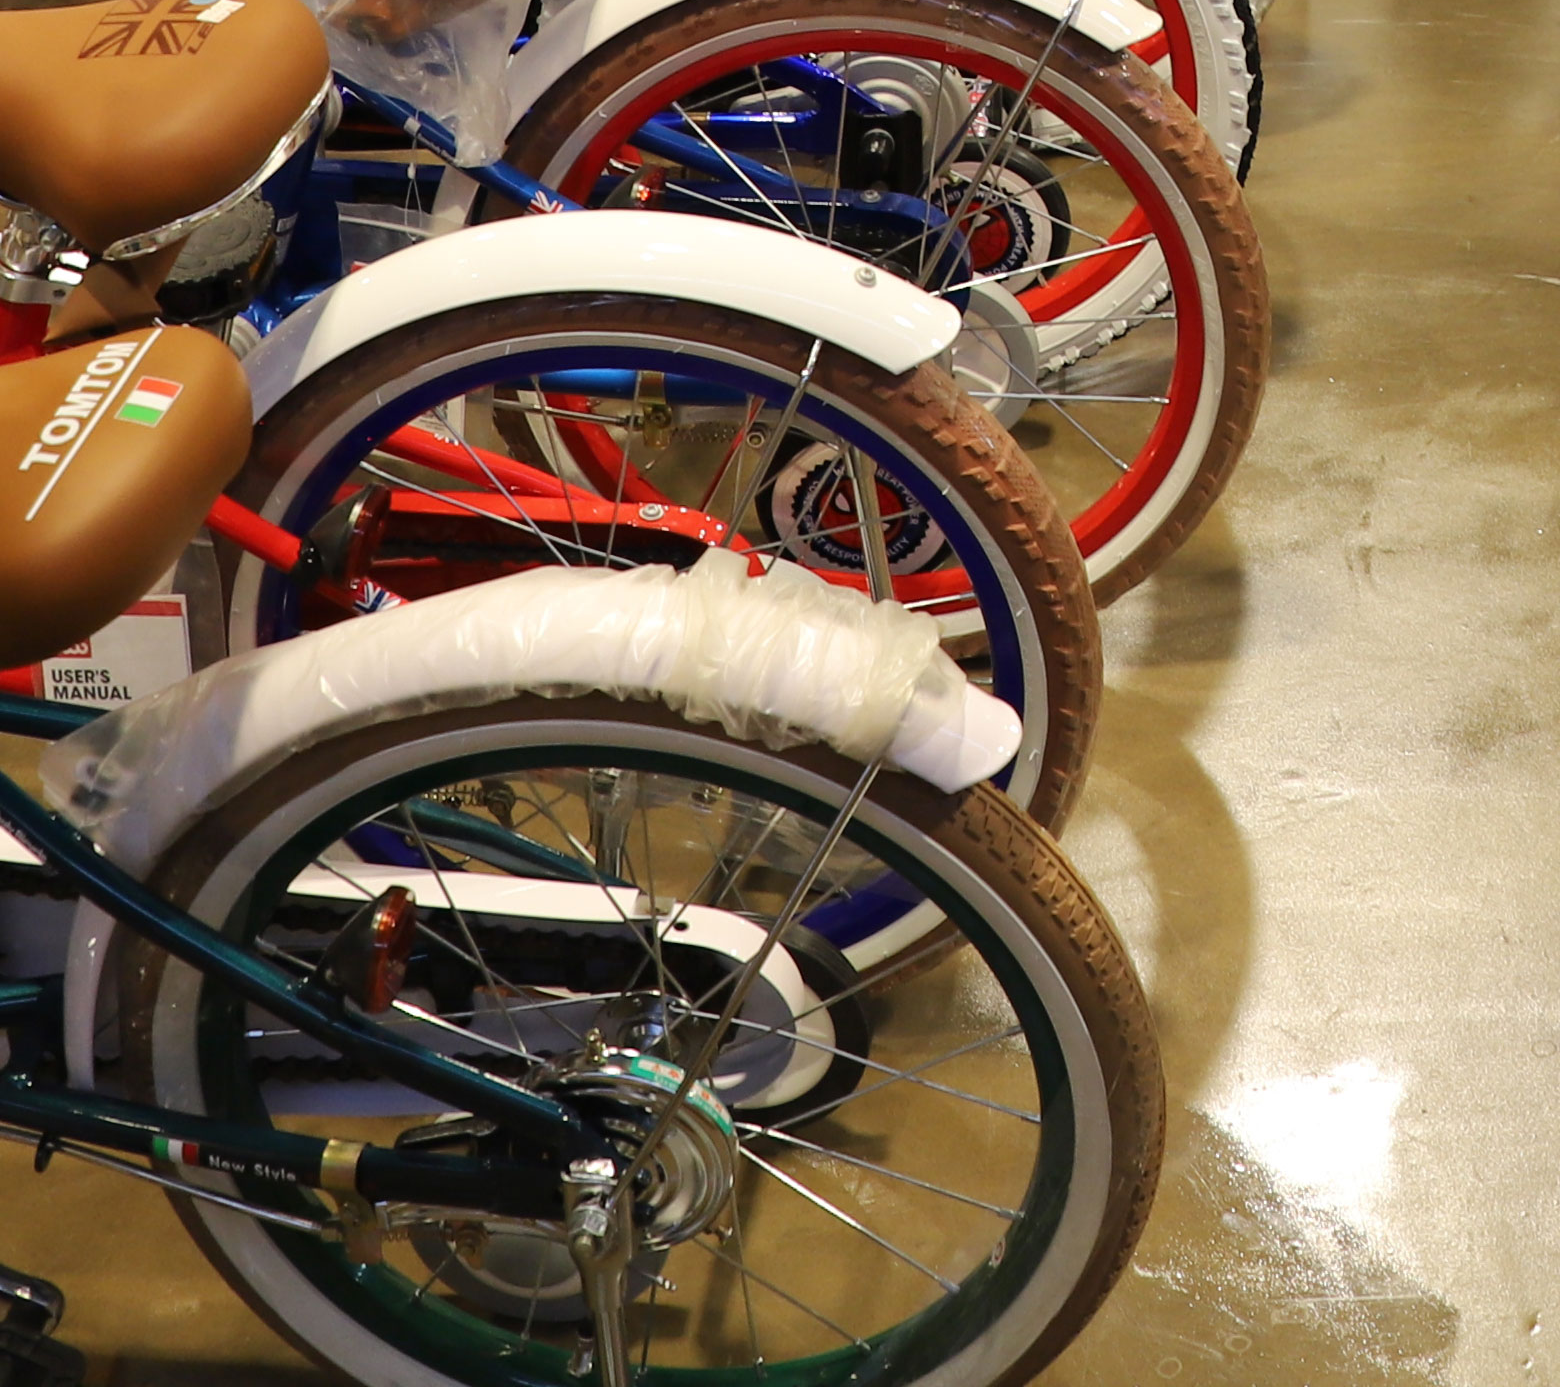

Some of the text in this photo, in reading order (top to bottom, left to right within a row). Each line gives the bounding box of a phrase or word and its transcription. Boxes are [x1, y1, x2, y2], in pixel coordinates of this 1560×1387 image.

[18, 342, 139, 471] TOMTOM
[51, 669, 111, 684] USER'S
[53, 686, 132, 700] MANUAL
[208, 1154, 297, 1182] New Style
